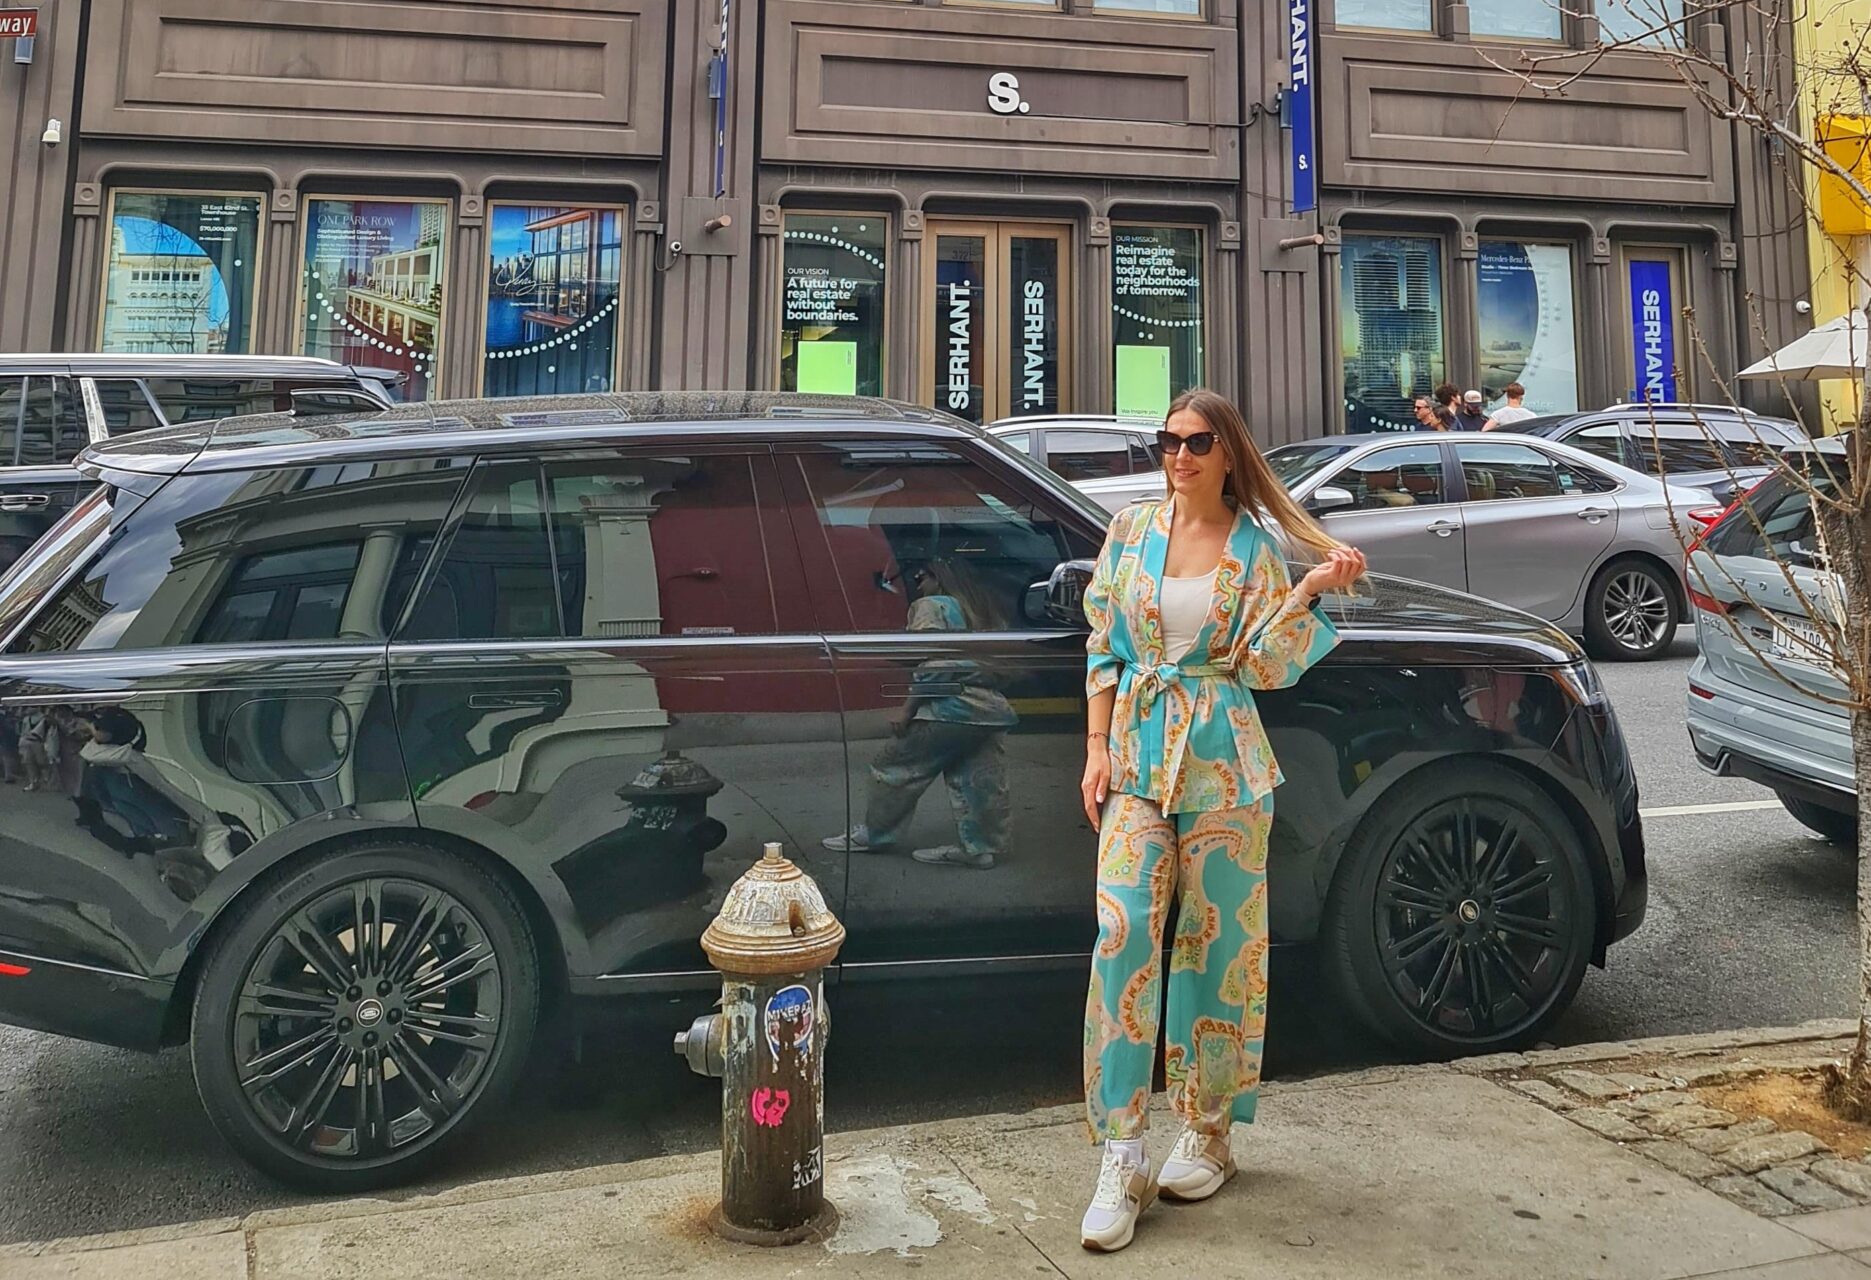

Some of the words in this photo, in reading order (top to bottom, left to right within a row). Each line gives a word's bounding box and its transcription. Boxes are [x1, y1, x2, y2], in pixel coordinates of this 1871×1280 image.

[987, 72, 1030, 114] S.
[1298, 154, 1308, 170] S.
[317, 214, 340, 225] ONE
[342, 215, 368, 225] PARK
[371, 216, 397, 227] ROW
[1131, 235, 1159, 243] MISSION
[1115, 244, 1176, 258] Reimagine
[1115, 255, 1137, 265] real
[1138, 256, 1174, 266] estate
[1480, 254, 1524, 264] Mercedes-Benz
[787, 267, 804, 275] OUR
[805, 268, 830, 276] VISION
[1115, 265, 1148, 278] today
[1149, 266, 1166, 276] for
[1166, 266, 1187, 276] the
[787, 277, 798, 288] A
[799, 277, 838, 289] future
[840, 278, 858, 289] for
[1115, 274, 1200, 287] neighborhoods
[787, 288, 810, 299] real
[812, 289, 852, 300] estate
[1116, 284, 1128, 295] of
[1129, 286, 1188, 297] tomorrow.
[786, 298, 836, 310] without
[786, 308, 859, 321] boundaries.
[948, 280, 971, 410] SERHANT.
[1023, 280, 1044, 410] SERHANT.
